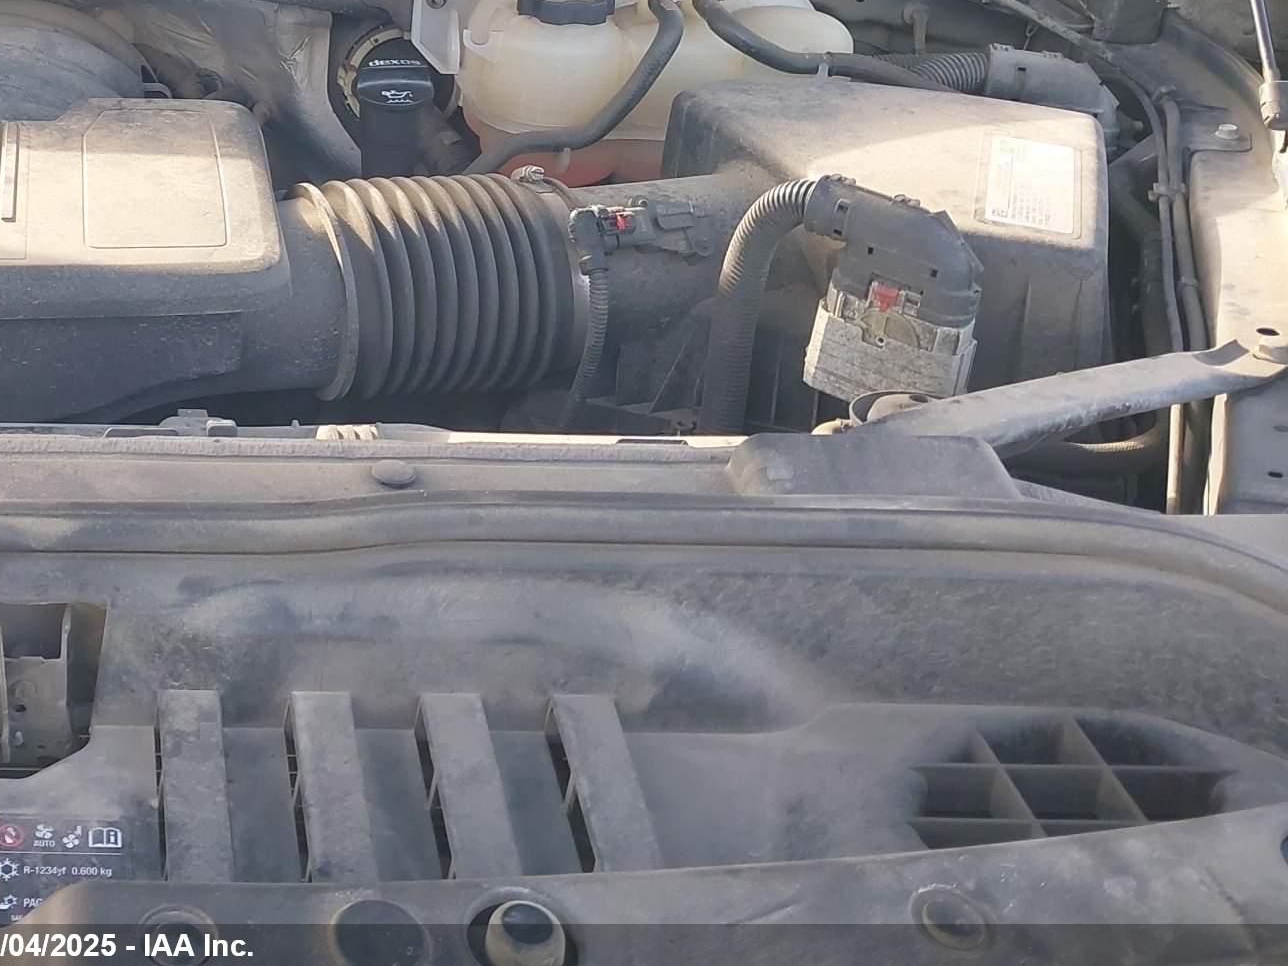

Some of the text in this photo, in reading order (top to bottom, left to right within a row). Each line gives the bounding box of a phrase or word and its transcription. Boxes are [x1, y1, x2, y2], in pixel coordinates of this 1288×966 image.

[368, 59, 421, 67] dexos
[32, 839, 56, 848] AUTO
[22, 865, 113, 878] R-1234yf 0.600 kg
